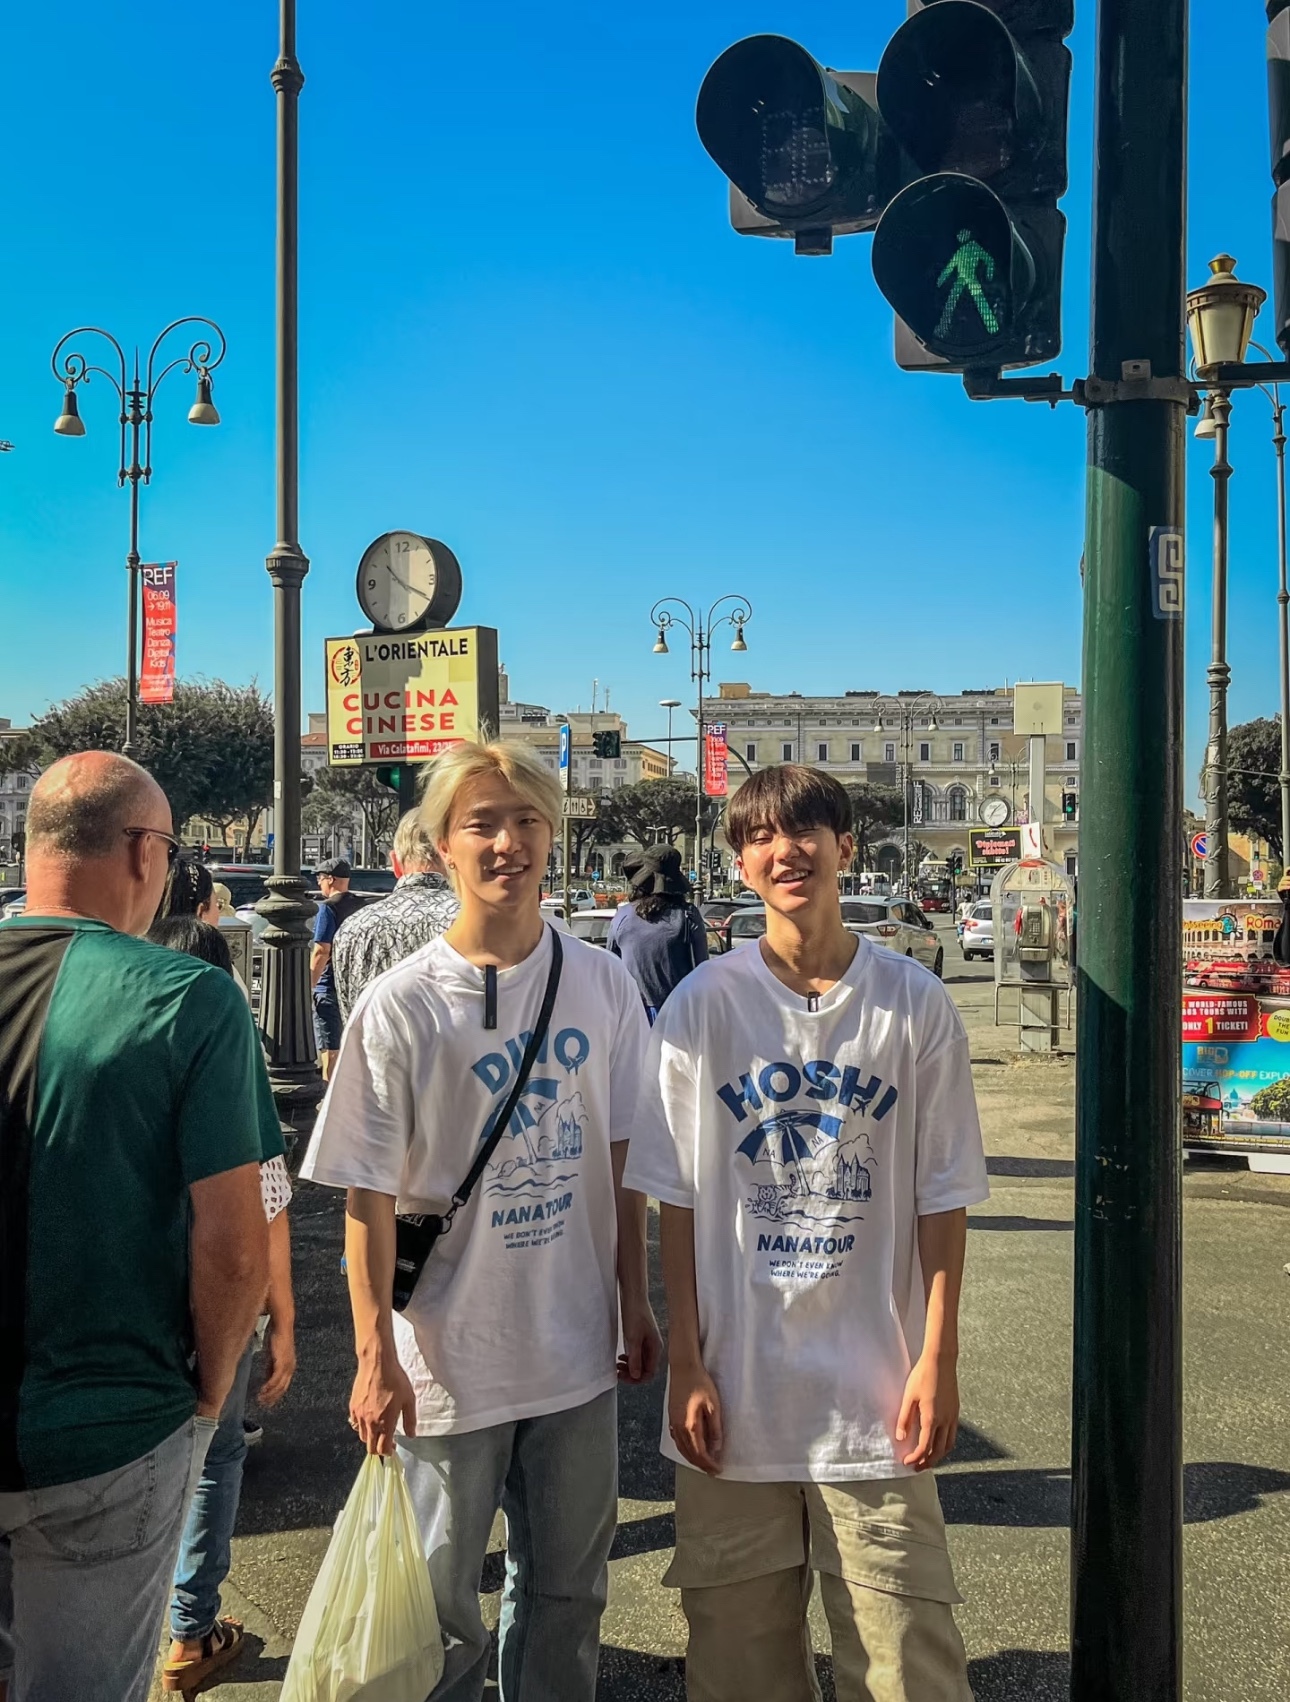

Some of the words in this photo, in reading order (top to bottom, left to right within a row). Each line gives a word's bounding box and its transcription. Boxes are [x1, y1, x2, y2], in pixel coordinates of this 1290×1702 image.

[395, 541, 410, 553] 12
[143, 567, 173, 586] REF
[368, 579, 376, 590] 9
[146, 617, 172, 626] Musica
[397, 613, 406, 624] 6
[148, 627, 171, 637] Teatro
[147, 638, 171, 647] Danza
[365, 638, 469, 662] L'ORIENTALE
[342, 688, 459, 712] CUCINA
[346, 712, 455, 735] CINESE
[378, 745, 390, 755] Via
[1205, 1017, 1213, 1034] 1
[1216, 1021, 1248, 1030] TICKET!
[716, 1060, 898, 1122] HOSHI
[811, 1135, 825, 1148] NA
[762, 1147, 776, 1158] NA
[491, 1192, 573, 1228] NANATOUR
[757, 1234, 855, 1255] NANATOUR
[782, 1260, 803, 1268] DON'T
[797, 1271, 819, 1279] WE'RE
